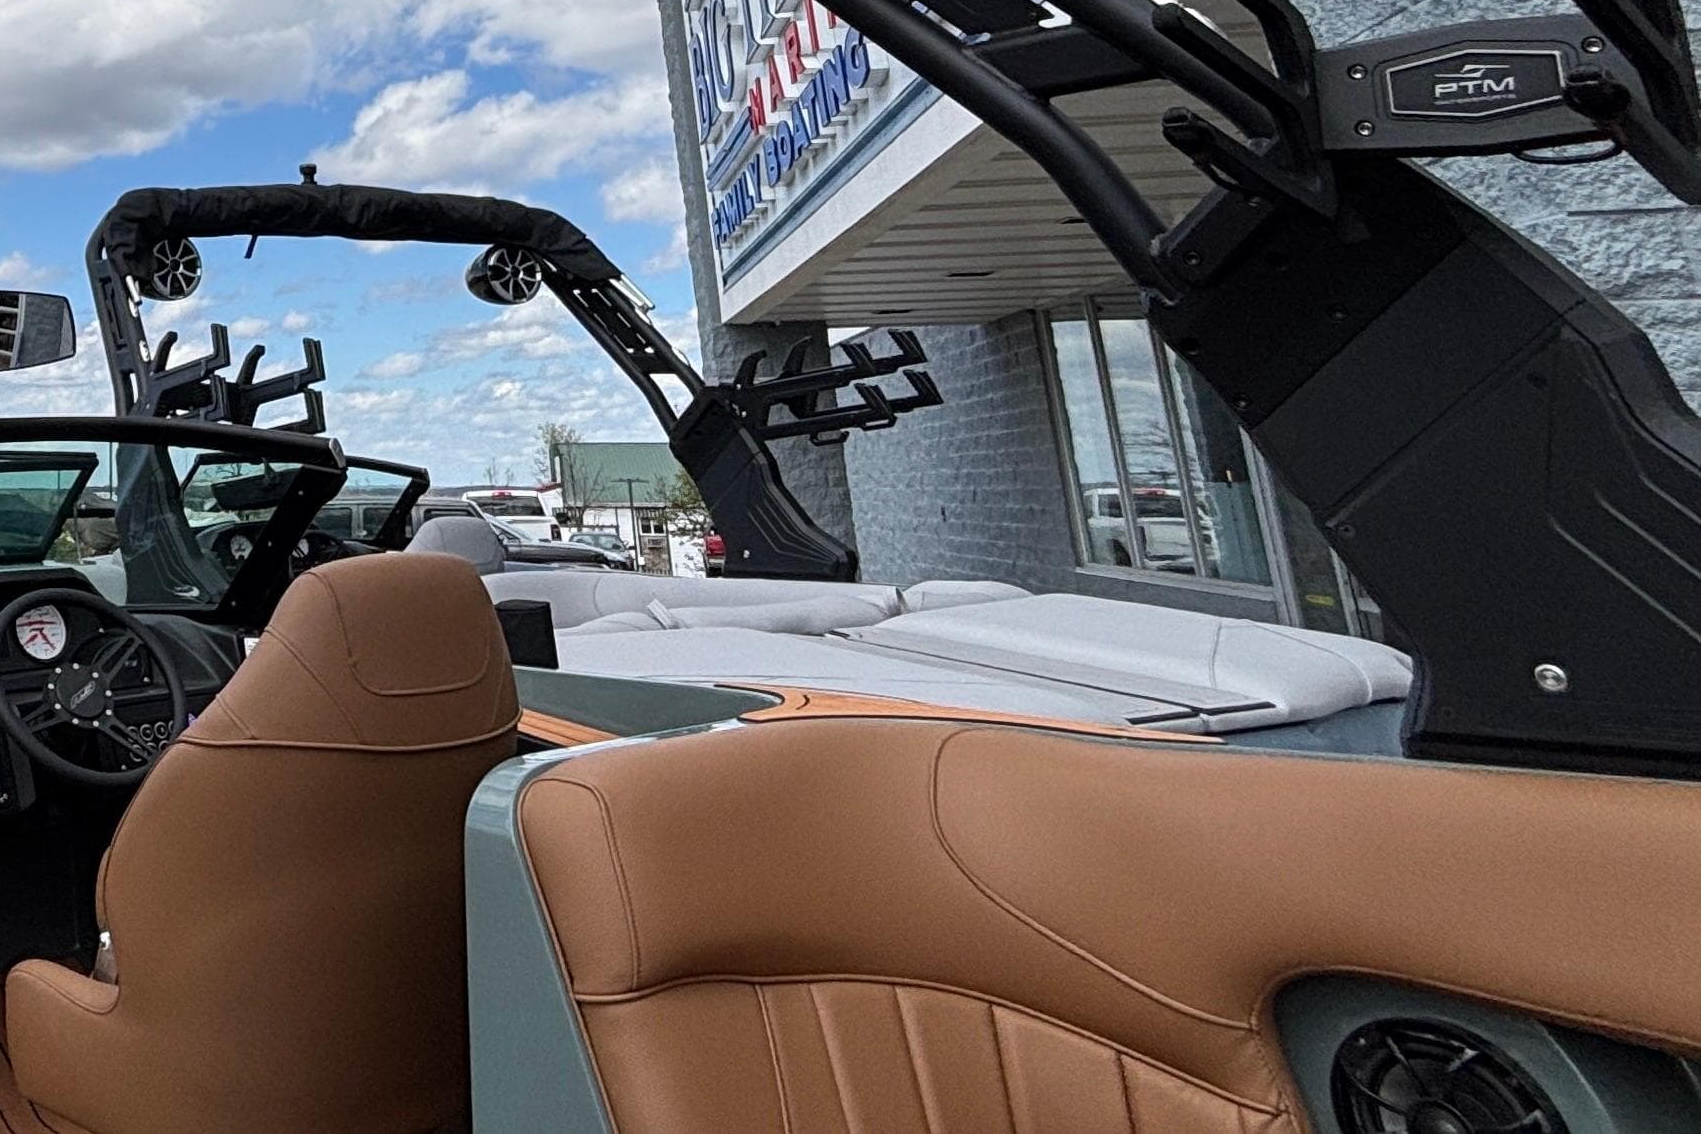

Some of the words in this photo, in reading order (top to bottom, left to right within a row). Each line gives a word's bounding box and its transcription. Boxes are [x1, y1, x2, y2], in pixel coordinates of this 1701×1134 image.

[711, 153, 762, 250] FAMILY
[763, 26, 870, 188] BOATING
[1434, 76, 1515, 98] PTM
